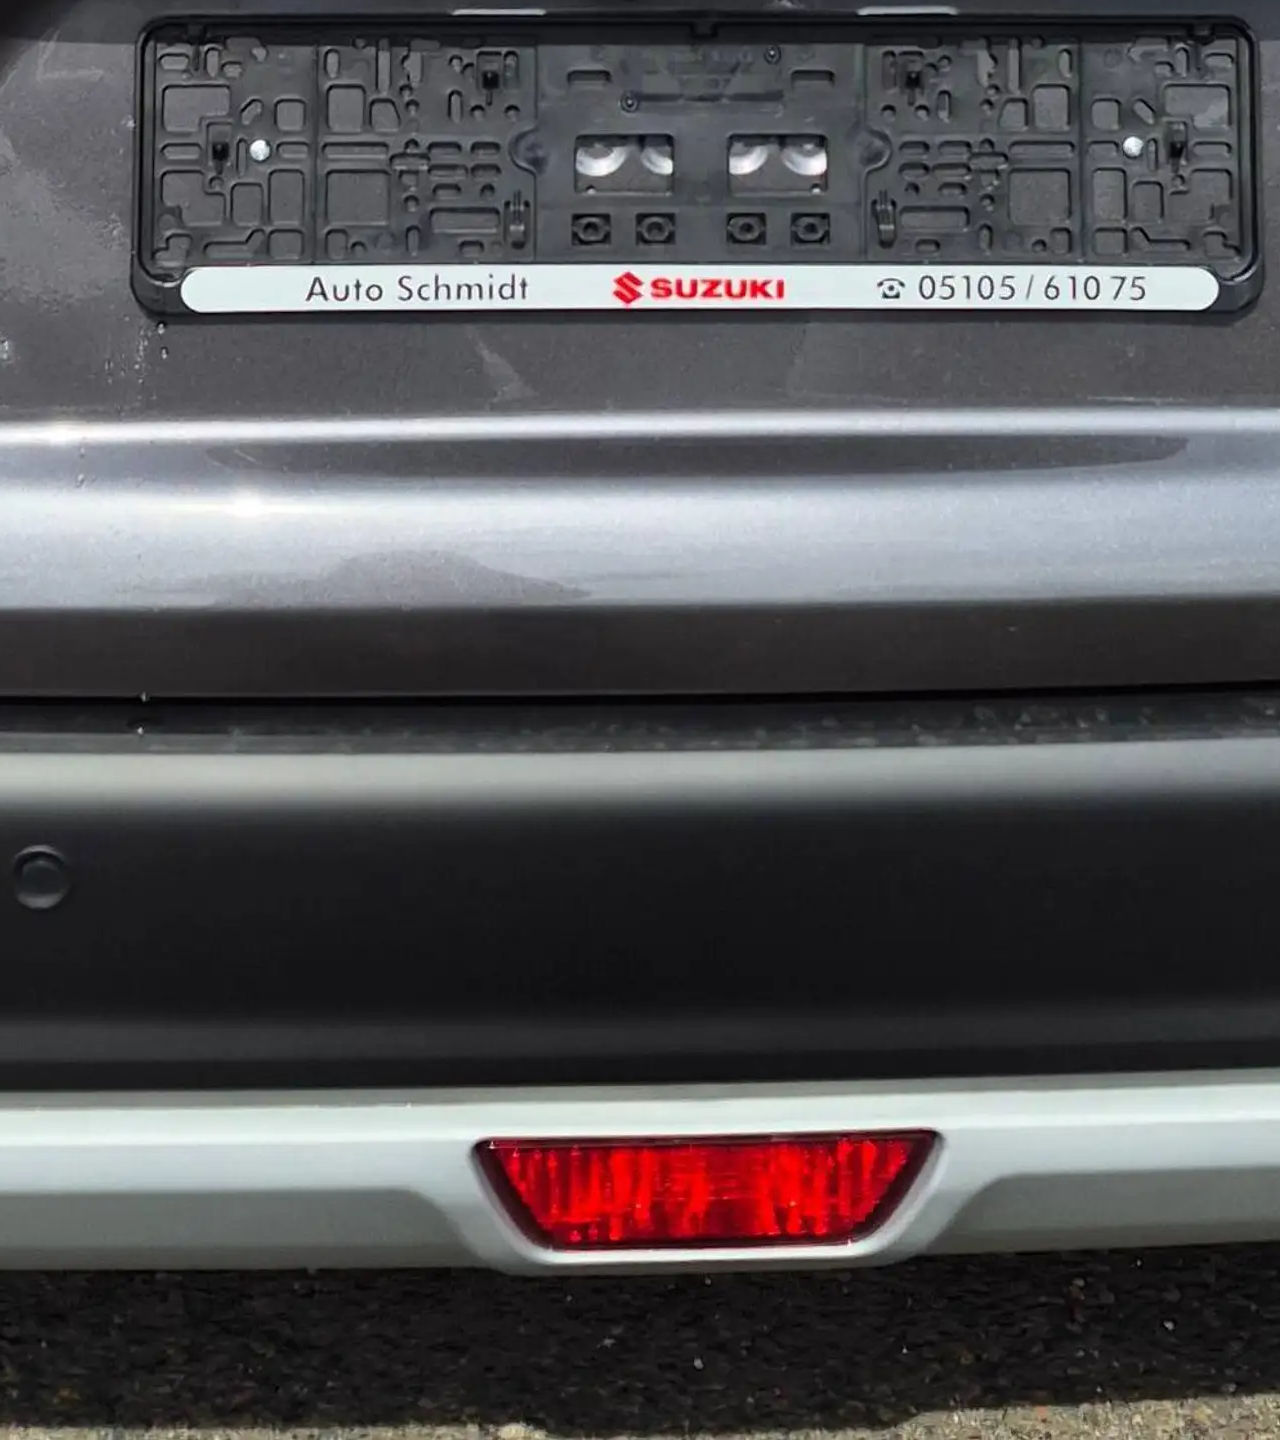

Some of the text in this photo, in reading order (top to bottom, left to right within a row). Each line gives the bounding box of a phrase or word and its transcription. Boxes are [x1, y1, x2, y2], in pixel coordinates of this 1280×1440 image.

[305, 276, 384, 302] Auto
[397, 273, 529, 302] Schmidt
[650, 278, 785, 299] SUZUKI
